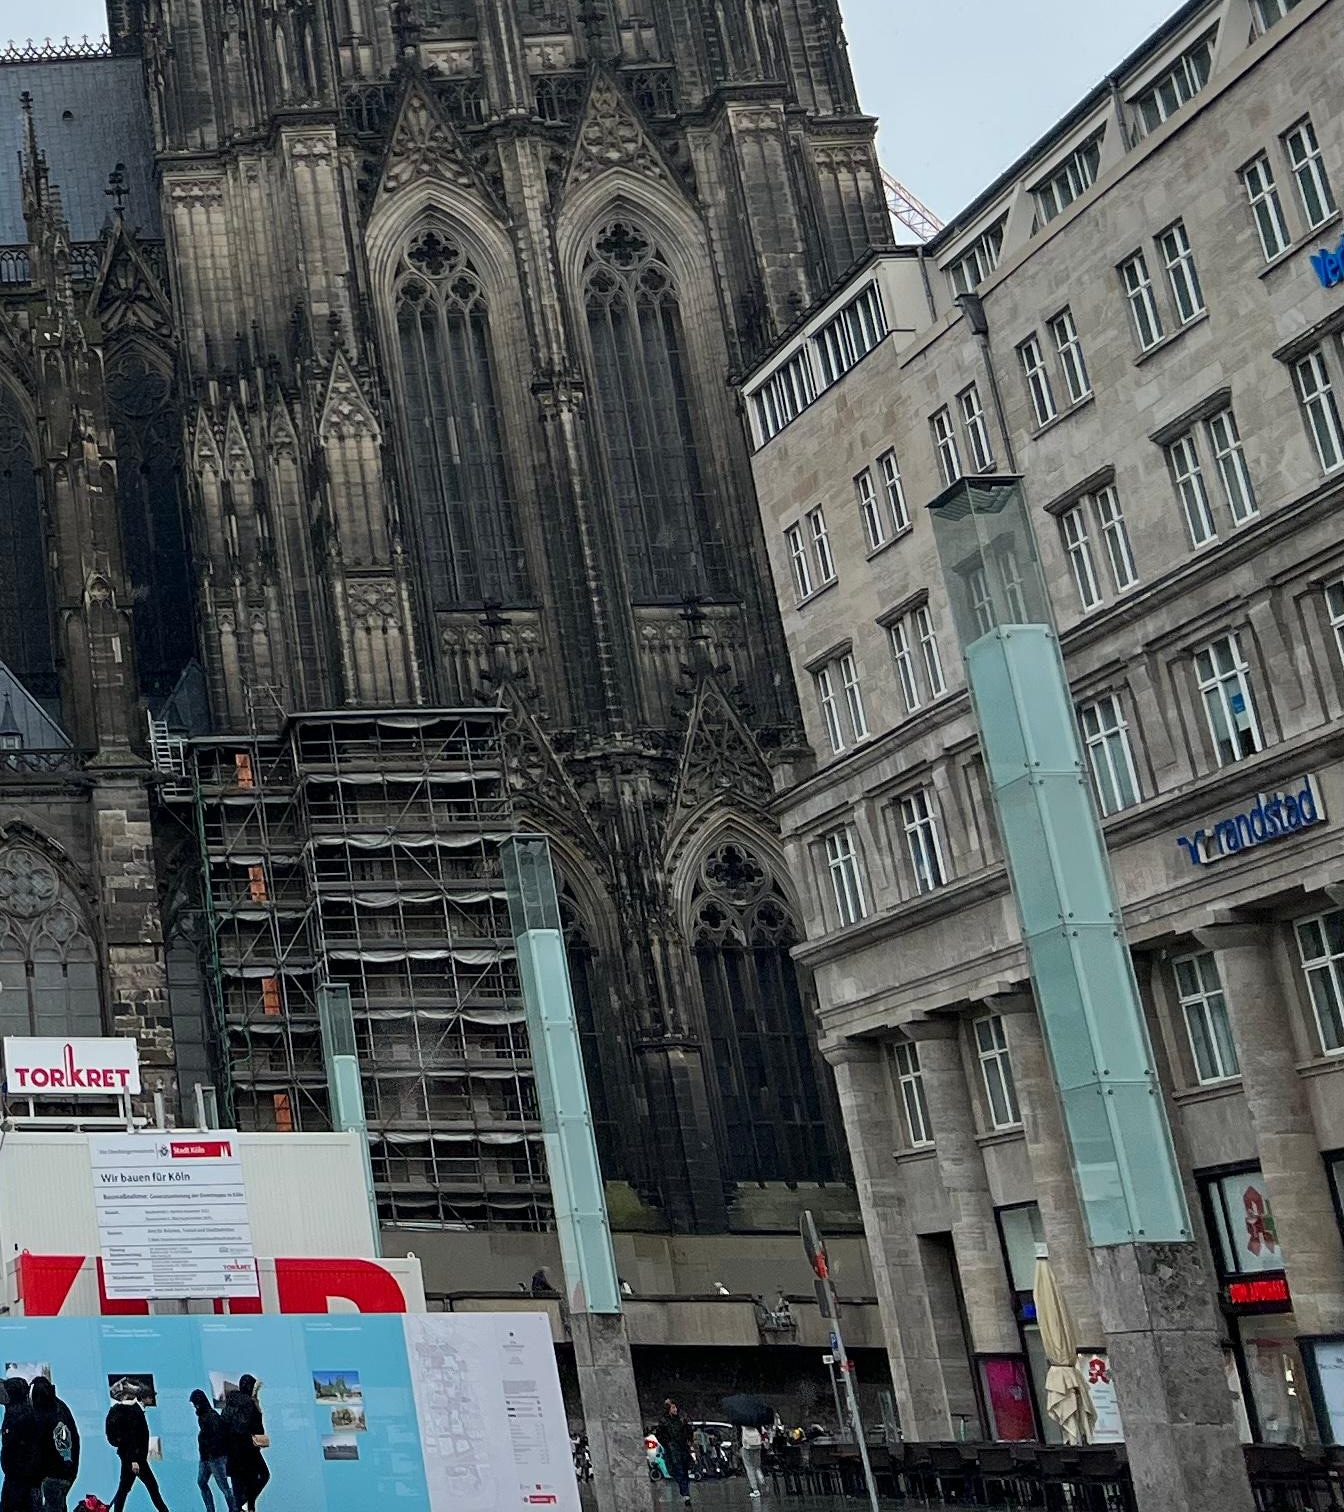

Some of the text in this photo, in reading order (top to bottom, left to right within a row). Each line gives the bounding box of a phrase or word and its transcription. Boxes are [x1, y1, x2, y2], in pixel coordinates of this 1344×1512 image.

[1310, 233, 1344, 288] Ve
[1214, 774, 1321, 855] randstad
[15, 1043, 130, 1087] TORKRET
[173, 1145, 206, 1154] Stadt Köln
[100, 1171, 191, 1183] Wir bauen für Köln
